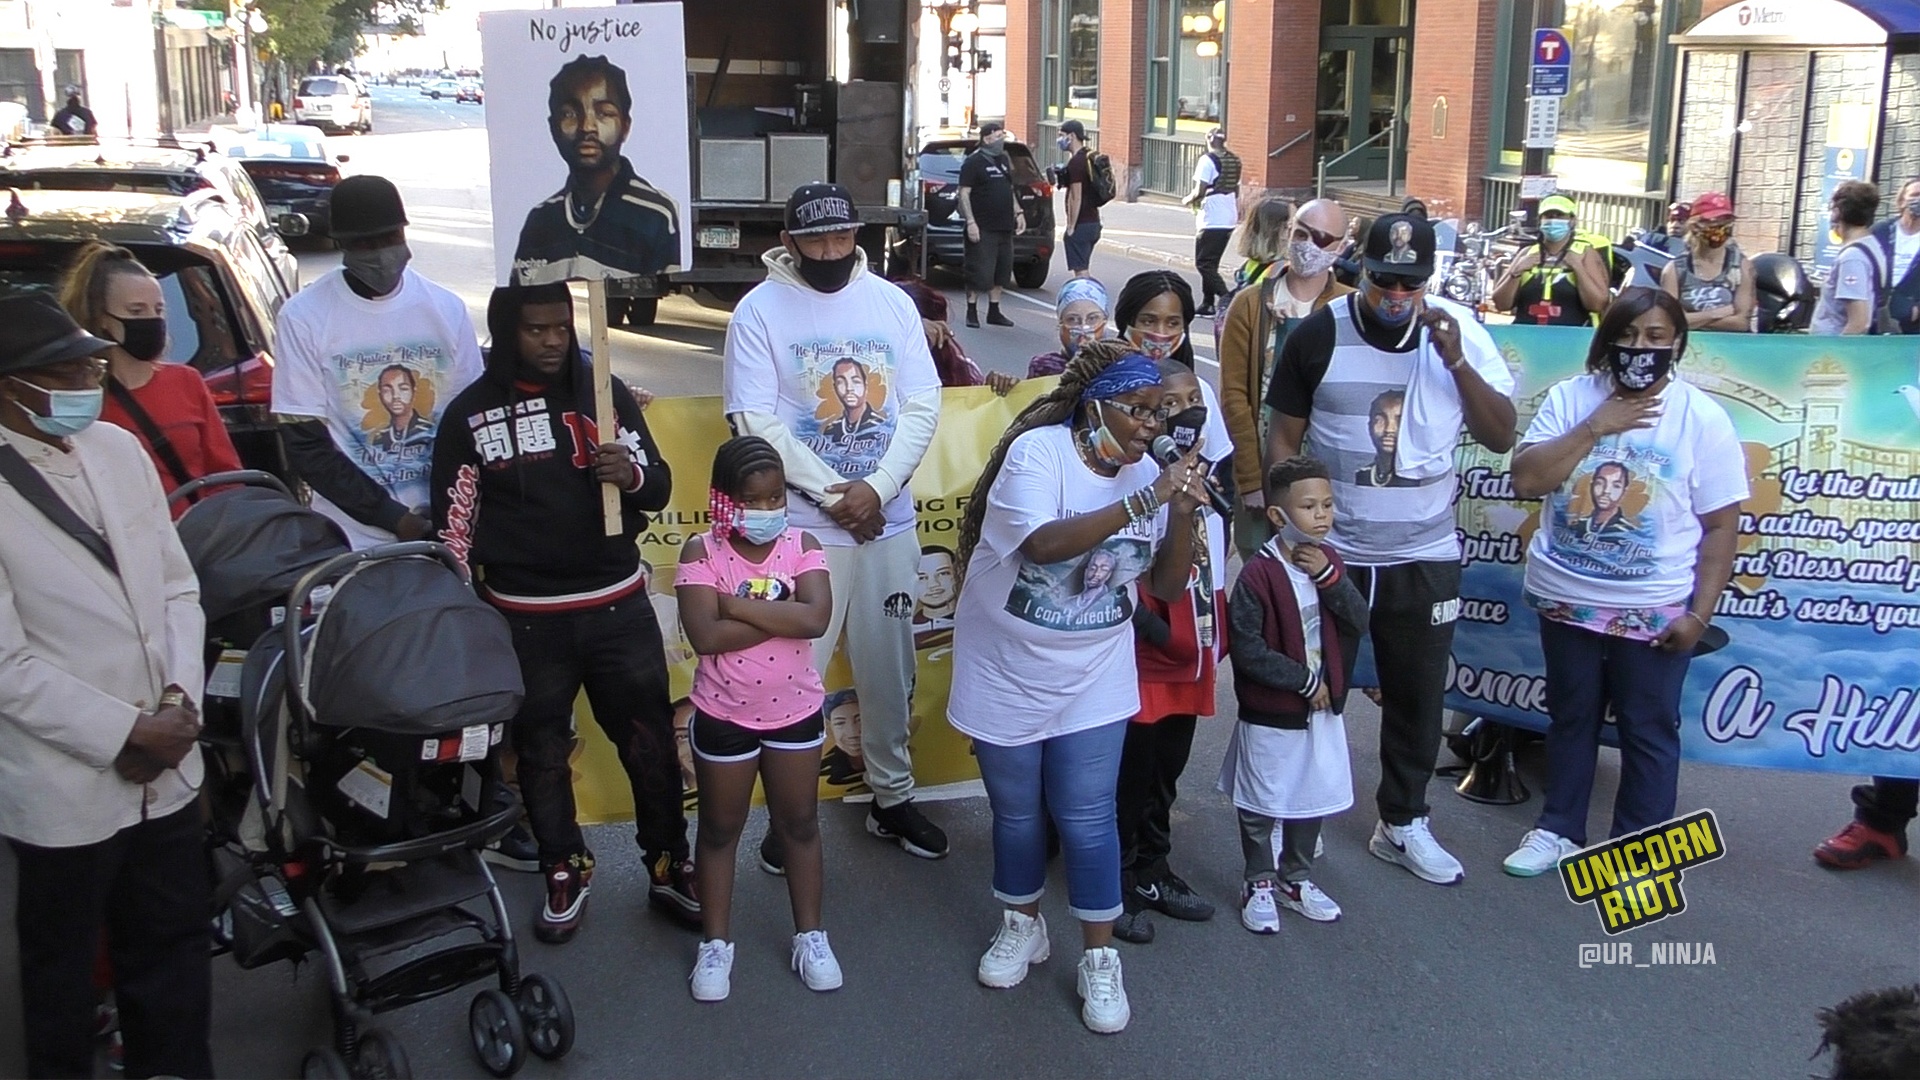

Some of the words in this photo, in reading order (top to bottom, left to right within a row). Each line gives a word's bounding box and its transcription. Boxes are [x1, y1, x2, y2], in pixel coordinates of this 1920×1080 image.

[530, 18, 557, 41] No
[560, 18, 642, 53] justice
[796, 199, 824, 227] TWIN
[332, 354, 355, 370] No
[789, 342, 809, 358] No
[812, 342, 843, 359] Justice
[845, 340, 864, 355] No
[866, 340, 891, 353] Peace
[803, 435, 832, 453] We
[841, 433, 874, 456] Love
[1781, 469, 1818, 500] Let
[1823, 471, 1862, 496] the
[641, 532, 699, 546] AG
[1759, 511, 1847, 541] action,
[1583, 533, 1616, 552] Love
[1617, 539, 1653, 564] You
[1773, 551, 1843, 578] Bless
[1848, 558, 1907, 583] and
[1023, 599, 1032, 614] I
[1034, 606, 1073, 626] can't
[1798, 598, 1869, 624] seeks
